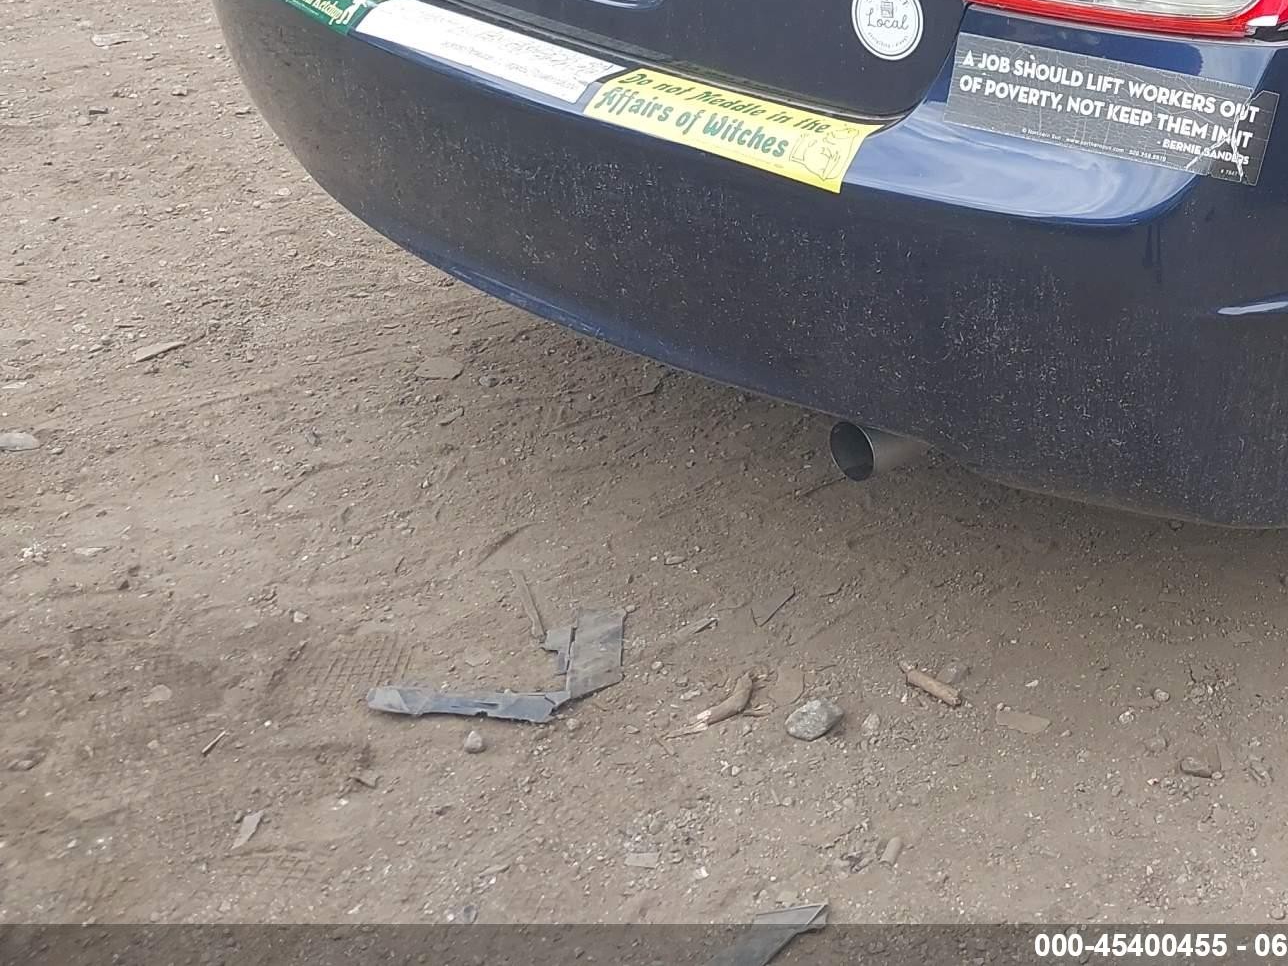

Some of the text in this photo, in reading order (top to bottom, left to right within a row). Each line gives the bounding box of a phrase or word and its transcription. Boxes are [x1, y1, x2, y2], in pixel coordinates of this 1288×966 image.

[866, 7, 910, 30] Local
[618, 72, 832, 134] Do not Meddle in the
[959, 74, 983, 93] OF
[984, 79, 1063, 112] POVERTY,
[1066, 95, 1105, 118] NOT
[1106, 103, 1152, 126] KEEP
[1157, 113, 1209, 139] THEM
[962, 49, 1260, 123] A JOB SHOULD LIFT WORKERS OUT
[594, 86, 674, 123] Affairs
[675, 108, 705, 135] of
[702, 112, 790, 158] Witches
[1162, 138, 1202, 155] BERNIE
[1201, 146, 1250, 165] SANDERS
